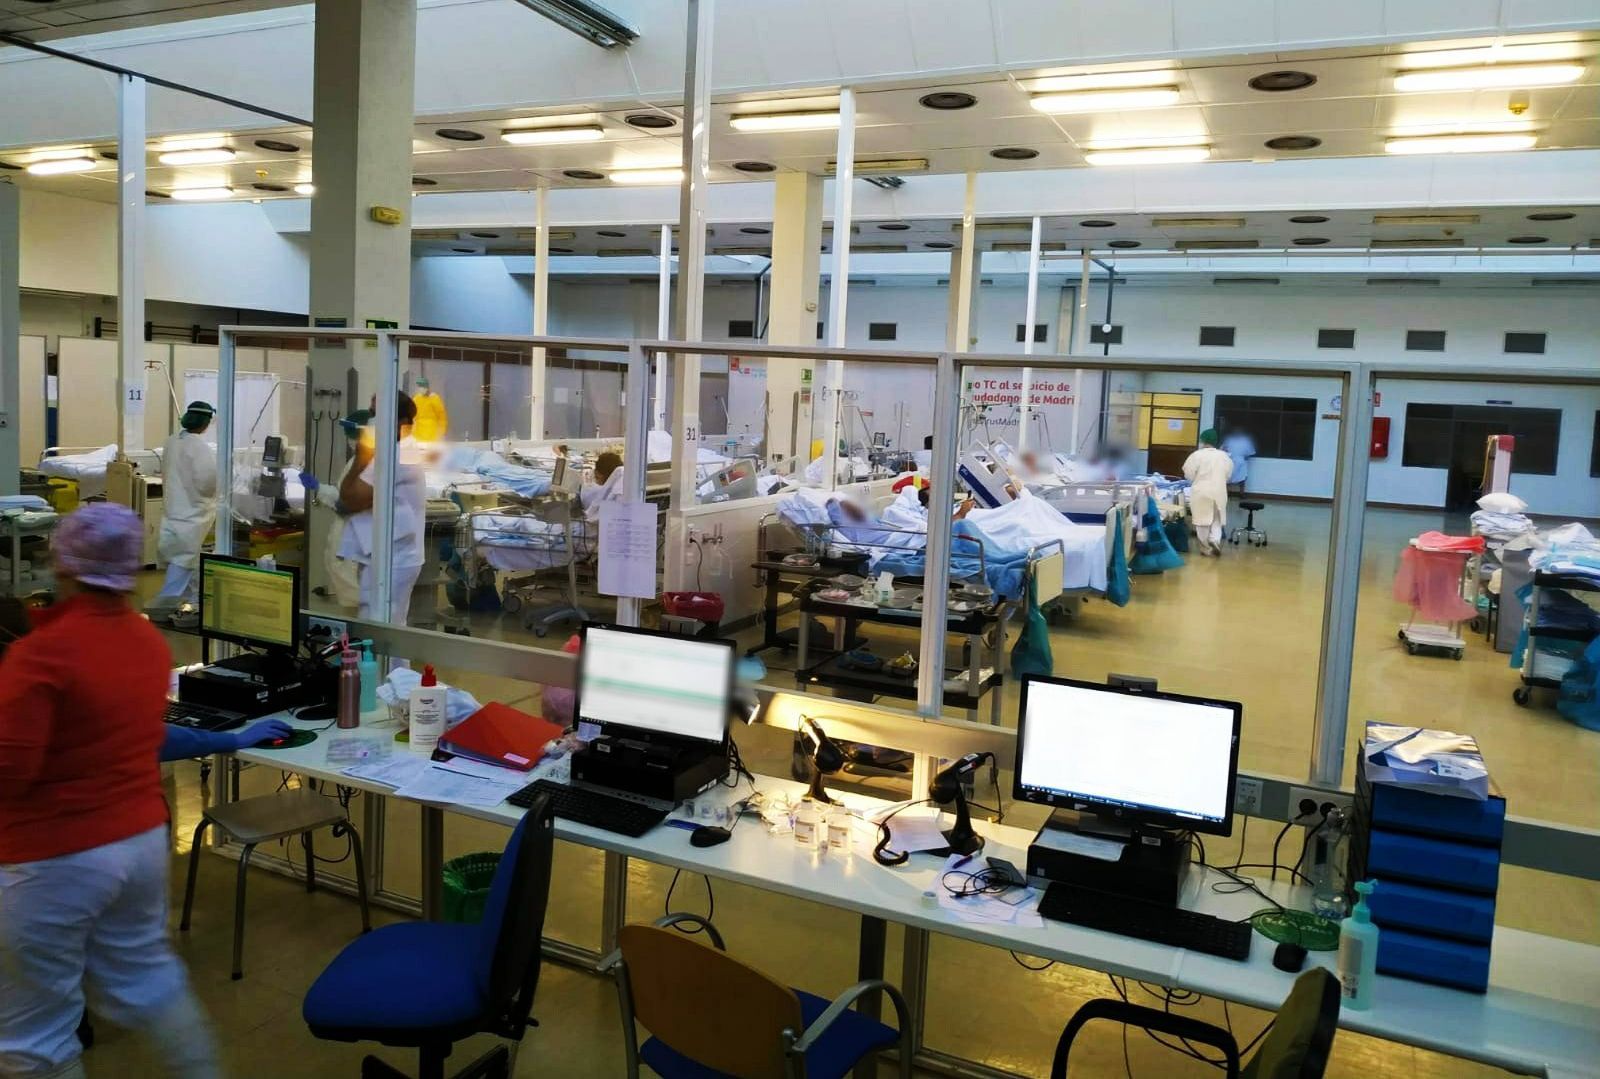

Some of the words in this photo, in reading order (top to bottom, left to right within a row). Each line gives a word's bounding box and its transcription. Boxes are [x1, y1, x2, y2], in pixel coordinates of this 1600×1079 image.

[984, 380, 997, 389] TC
[1000, 381, 1009, 389] al
[1013, 380, 1054, 391] seicio
[1057, 382, 1071, 391] de
[129, 389, 142, 401] 11
[972, 392, 1021, 403] udadano
[1043, 395, 1075, 405] Madri
[686, 427, 696, 441] 31
